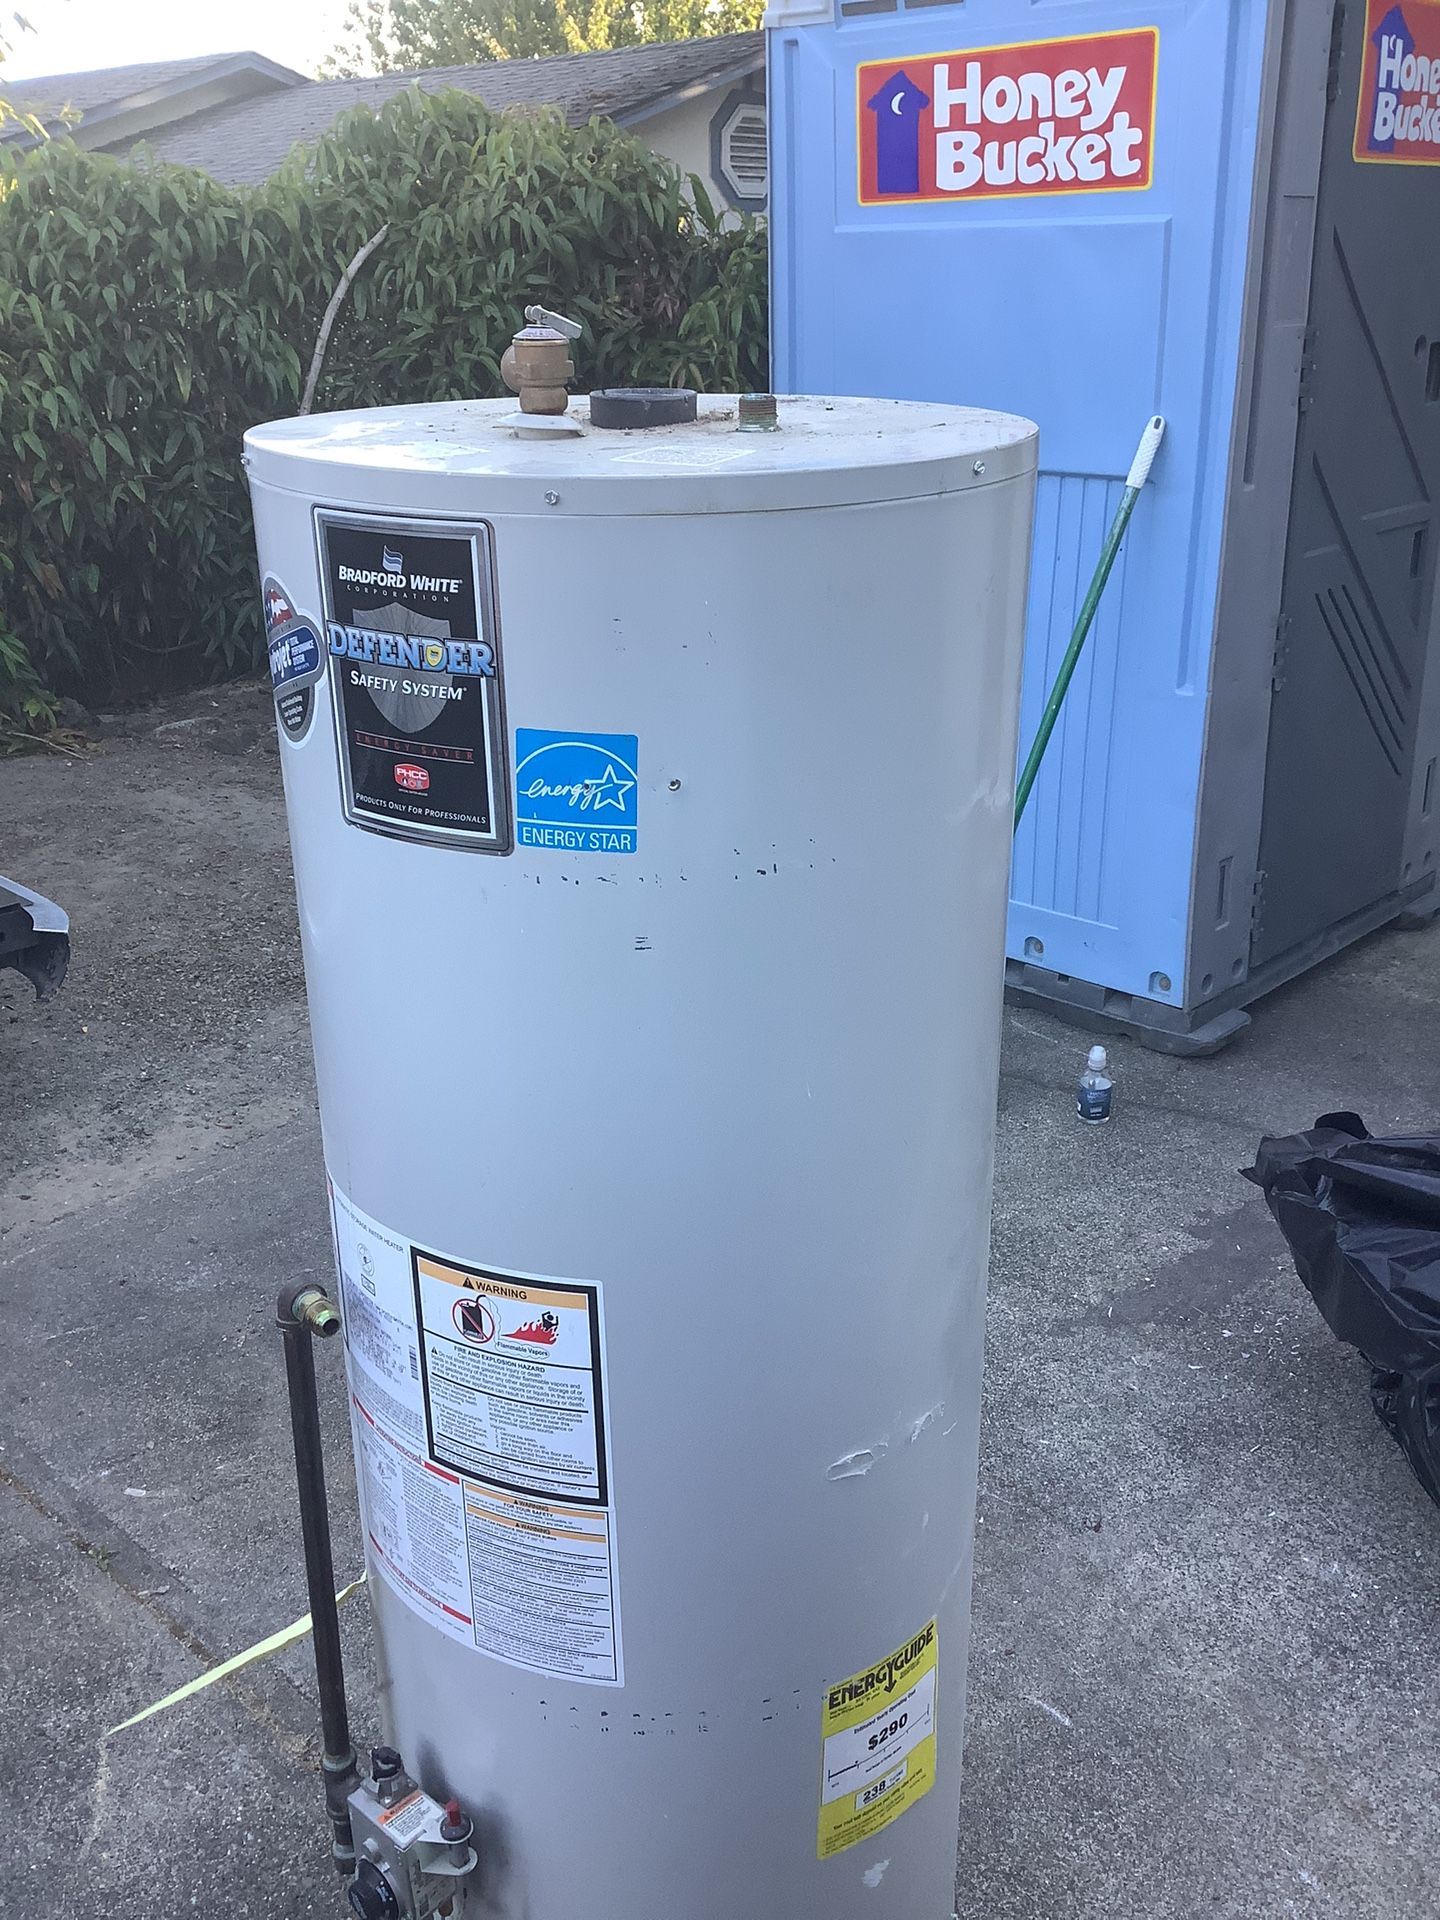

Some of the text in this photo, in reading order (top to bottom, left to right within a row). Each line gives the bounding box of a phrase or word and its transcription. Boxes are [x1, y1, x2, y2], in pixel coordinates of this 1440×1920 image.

[1379, 34, 1440, 94] Hone
[932, 61, 1127, 131] Honey
[1373, 91, 1440, 144] Bucke
[935, 111, 1143, 191] Bucket
[338, 565, 406, 588] BRADFORD
[346, 584, 450, 602] CORPORATION
[327, 621, 495, 677] DEFENDER
[350, 670, 398, 692] SAFETY
[356, 733, 473, 760] ENERGY SAVER
[396, 767, 428, 780] PHCC
[522, 826, 631, 850] ENERGY STAR
[475, 1280, 528, 1300] WARNING
[454, 1345, 545, 1373] FIRE AND EXPLOSION HAZARD
[497, 1341, 548, 1356] Flammable Vapors
[828, 1623, 934, 1710] ENERGYGUIDE
[868, 1712, 908, 1750] $290
[863, 1780, 886, 1802] 238
